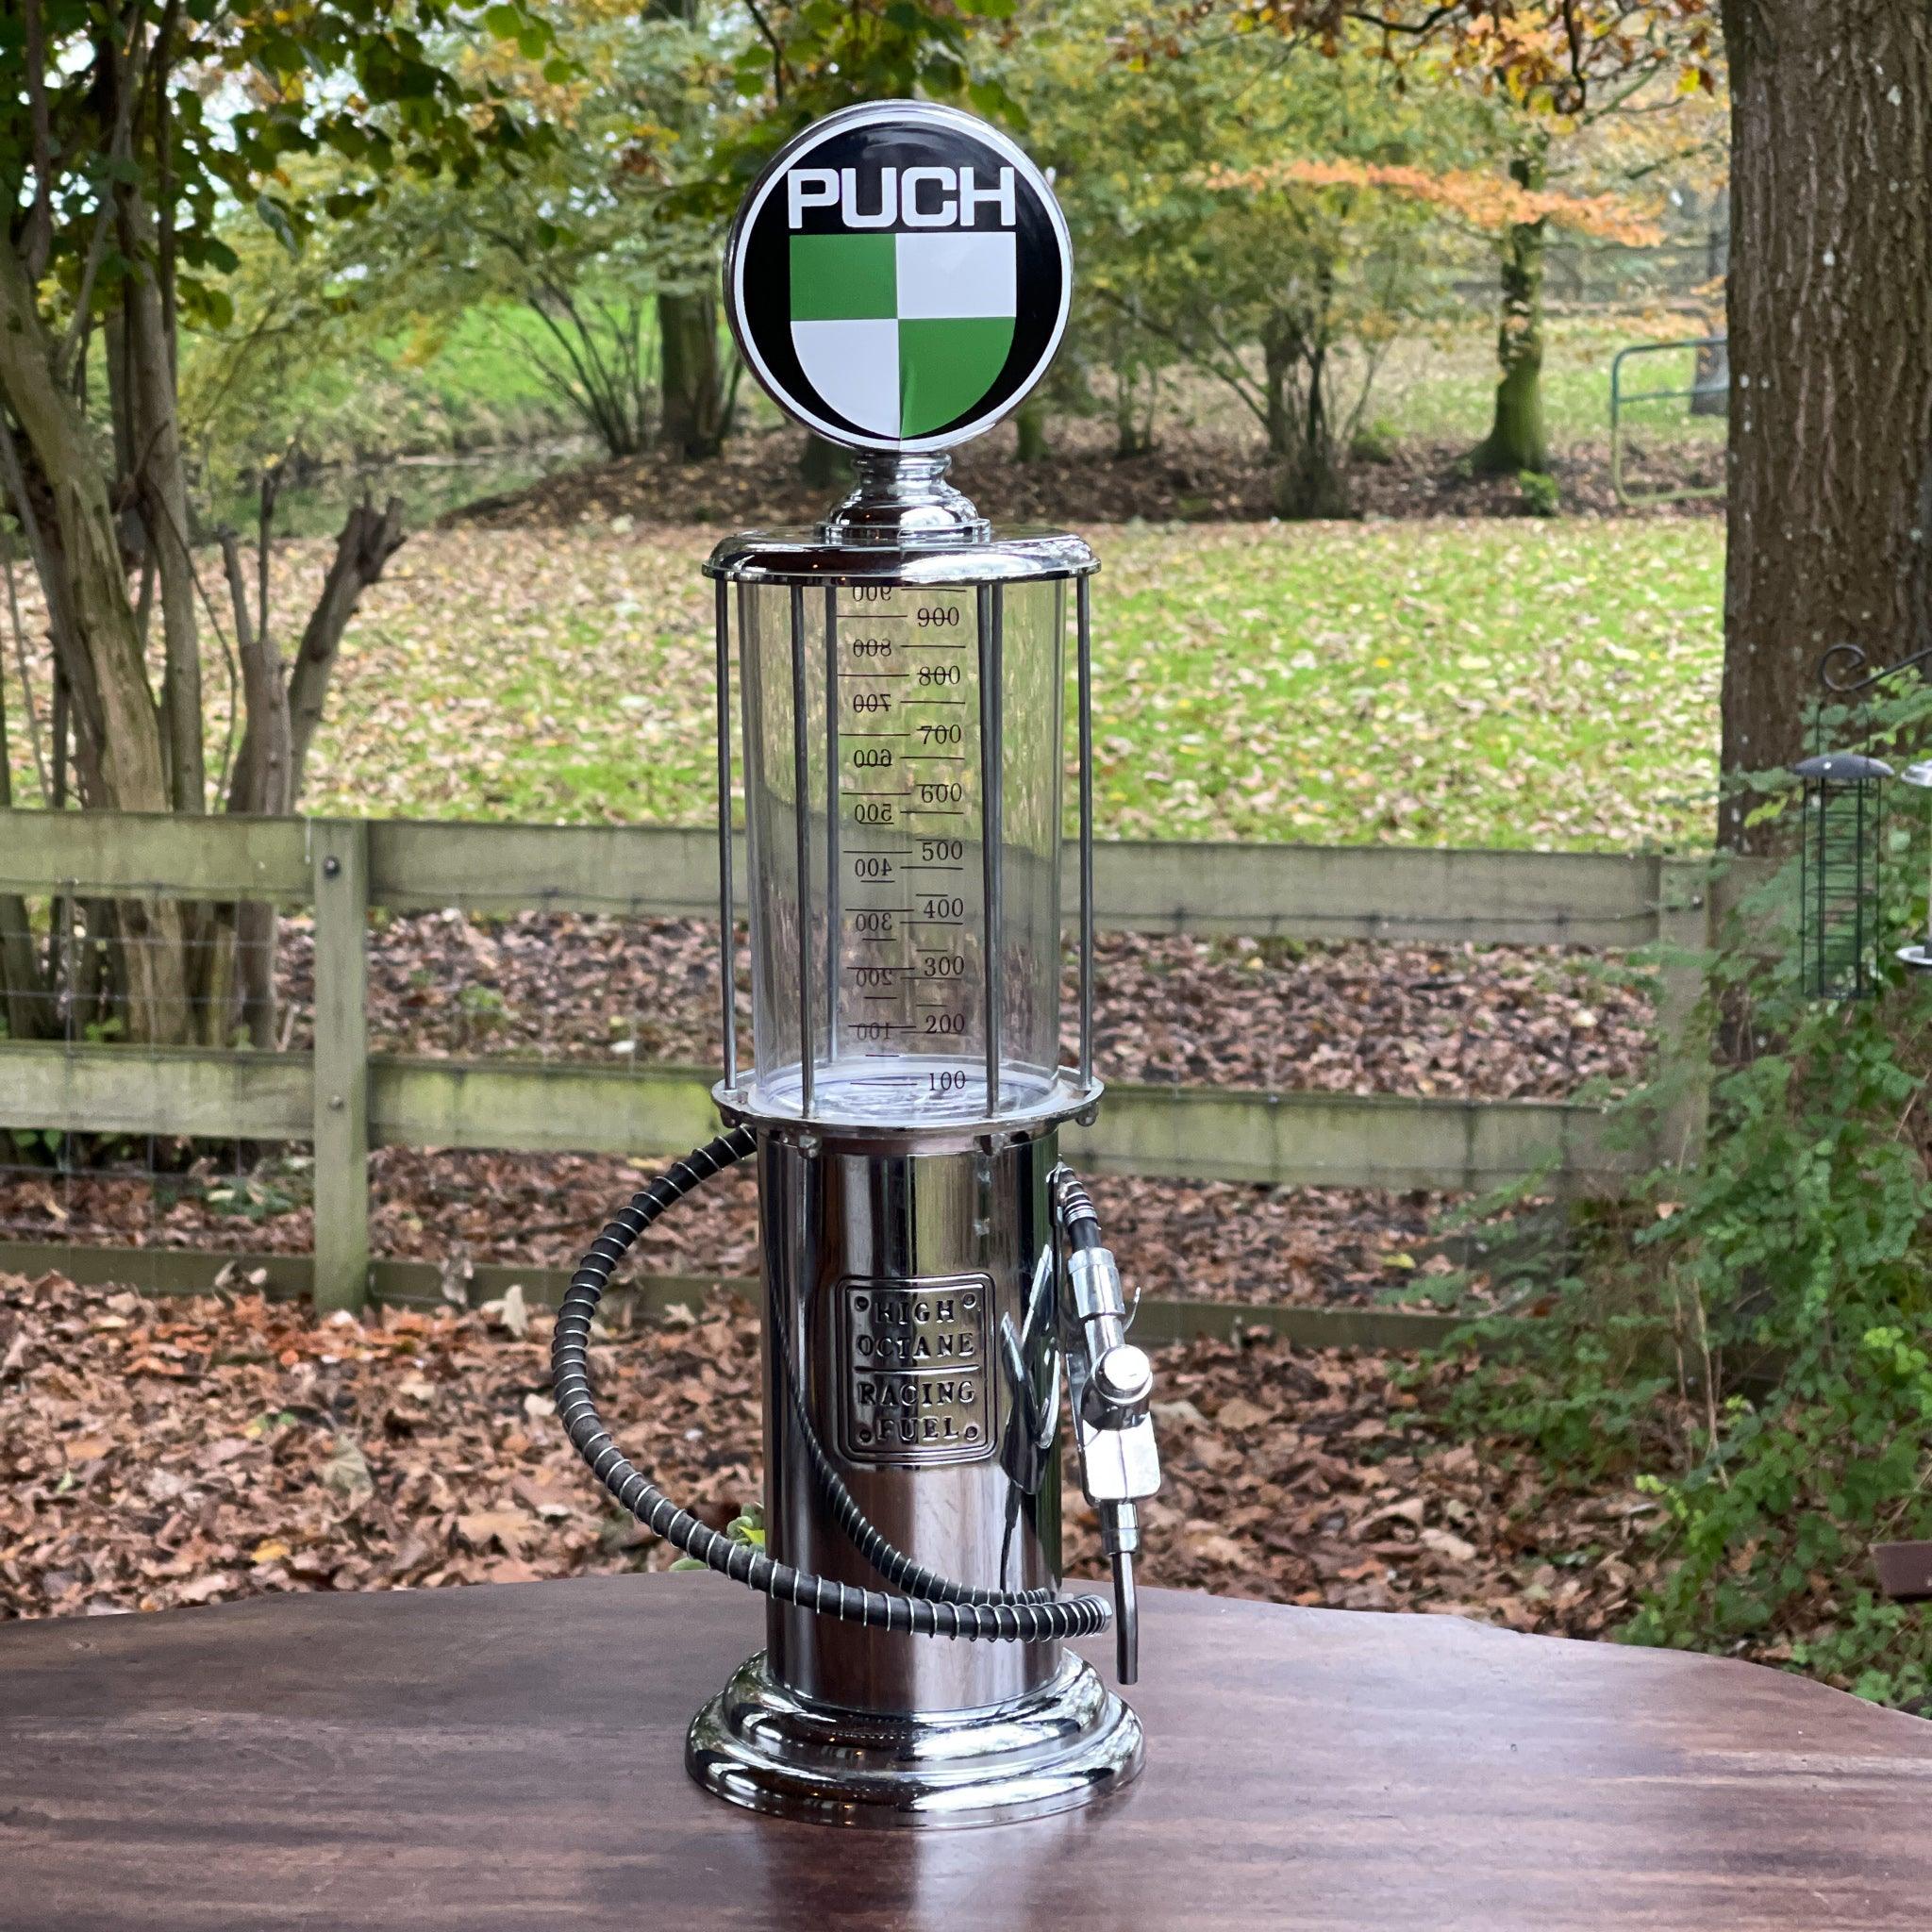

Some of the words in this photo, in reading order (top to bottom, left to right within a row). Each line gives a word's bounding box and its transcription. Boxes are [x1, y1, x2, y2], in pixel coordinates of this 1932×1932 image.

[788, 166, 1017, 229] PUCH
[917, 607, 960, 627] 900
[919, 665, 960, 687] 800
[919, 724, 961, 745] 700
[921, 783, 962, 804] 600
[922, 841, 963, 862] 500
[924, 898, 964, 919] 400
[924, 956, 965, 977] 300
[925, 1013, 965, 1035] 200
[928, 1071, 966, 1091] 100
[874, 1299, 955, 1325] HIGH
[858, 1332, 974, 1359] OCTANE
[858, 1380, 975, 1407] RACING
[876, 1416, 959, 1441] FUEL
